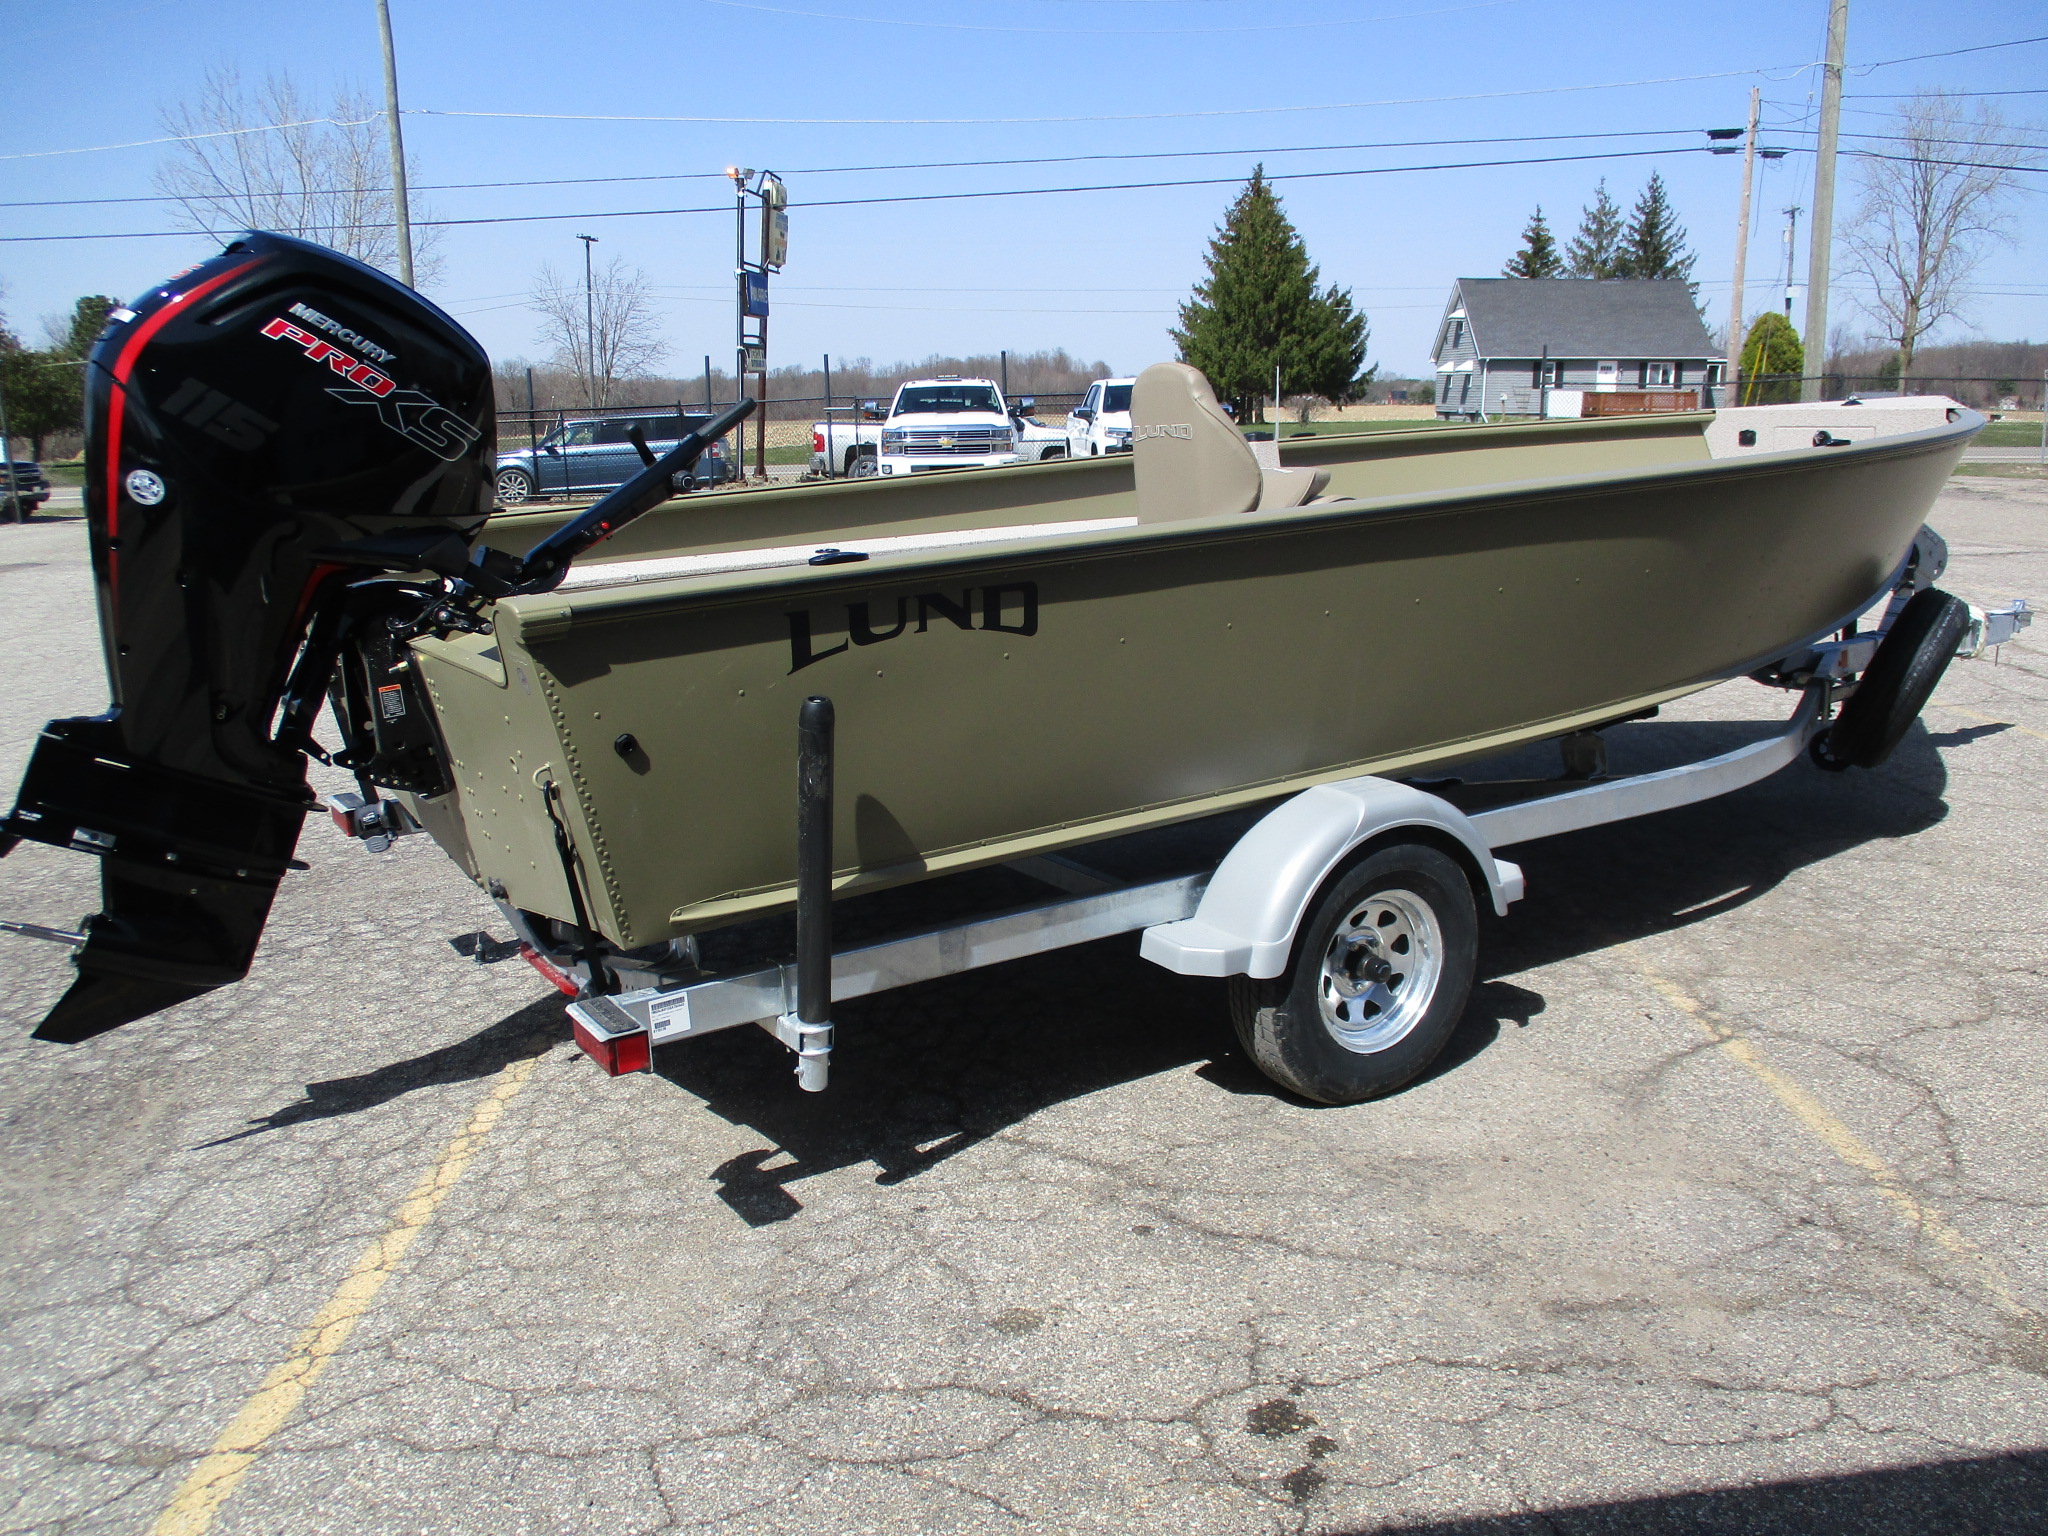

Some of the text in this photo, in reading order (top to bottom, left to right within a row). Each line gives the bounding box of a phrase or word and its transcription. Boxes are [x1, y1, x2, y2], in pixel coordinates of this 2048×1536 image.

[260, 317, 397, 398] PRO
[288, 302, 397, 363] MERCURY
[159, 377, 280, 451] 115
[324, 360, 482, 462] XS
[1133, 423, 1193, 442] LUND
[784, 581, 1039, 676] LUND
